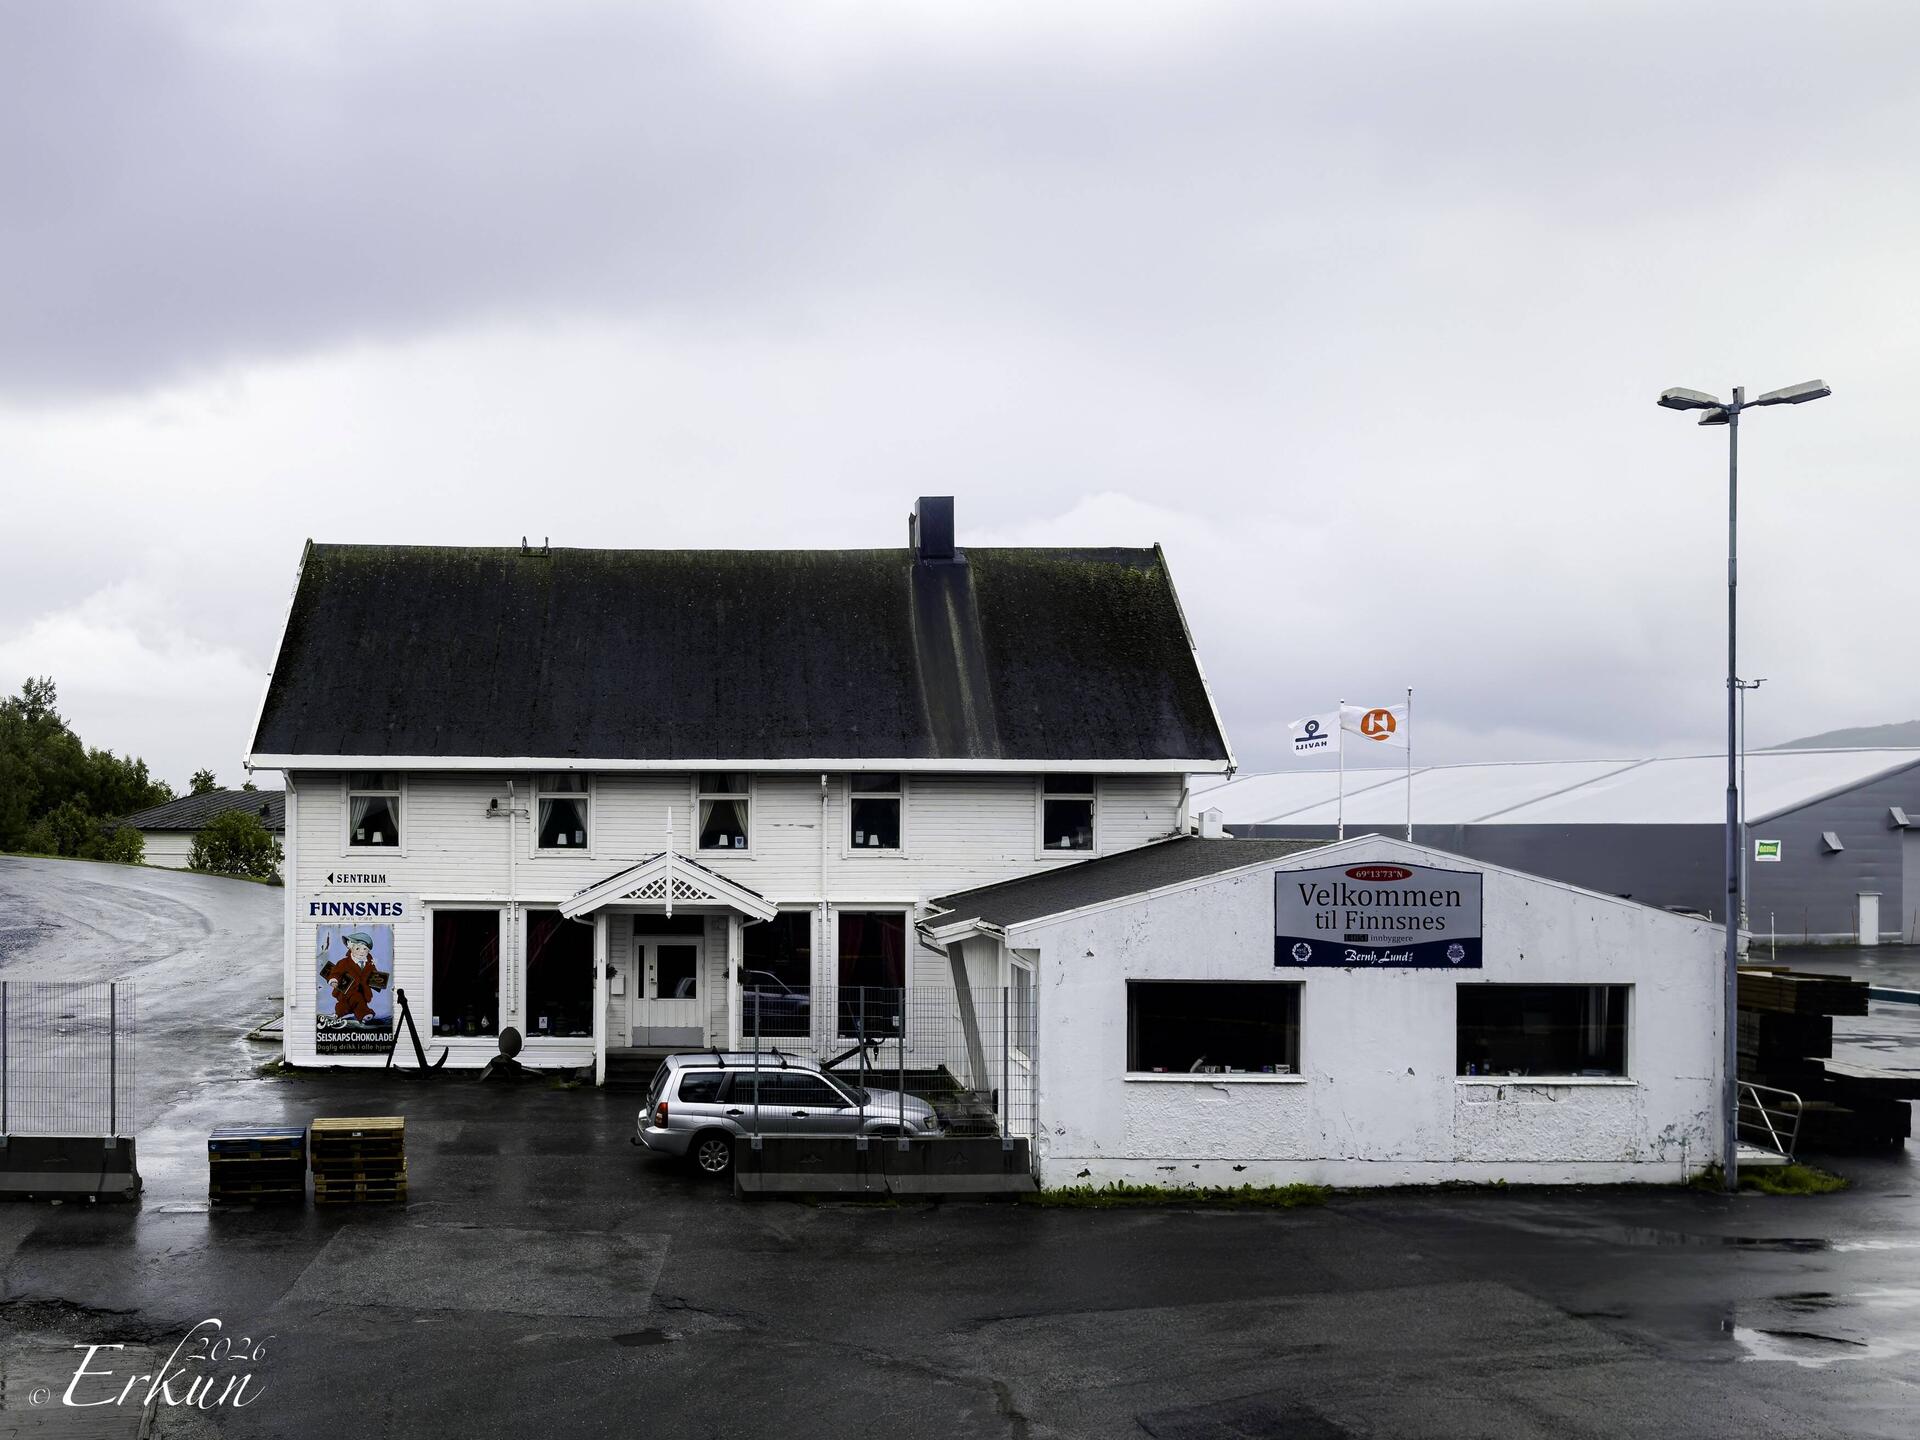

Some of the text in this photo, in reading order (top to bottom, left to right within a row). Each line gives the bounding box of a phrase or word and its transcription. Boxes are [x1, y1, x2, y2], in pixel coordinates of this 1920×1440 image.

[336, 873, 387, 885] SENTRUM
[1298, 883, 1462, 907] Velkommen
[309, 902, 403, 917] FINNSNES
[1315, 910, 1446, 930] til Finnsnes
[1370, 934, 1414, 944] innbyggere
[1378, 950, 1409, 964] Lund
[317, 1043, 338, 1052] Daglig
[339, 1043, 356, 1051] drikk
